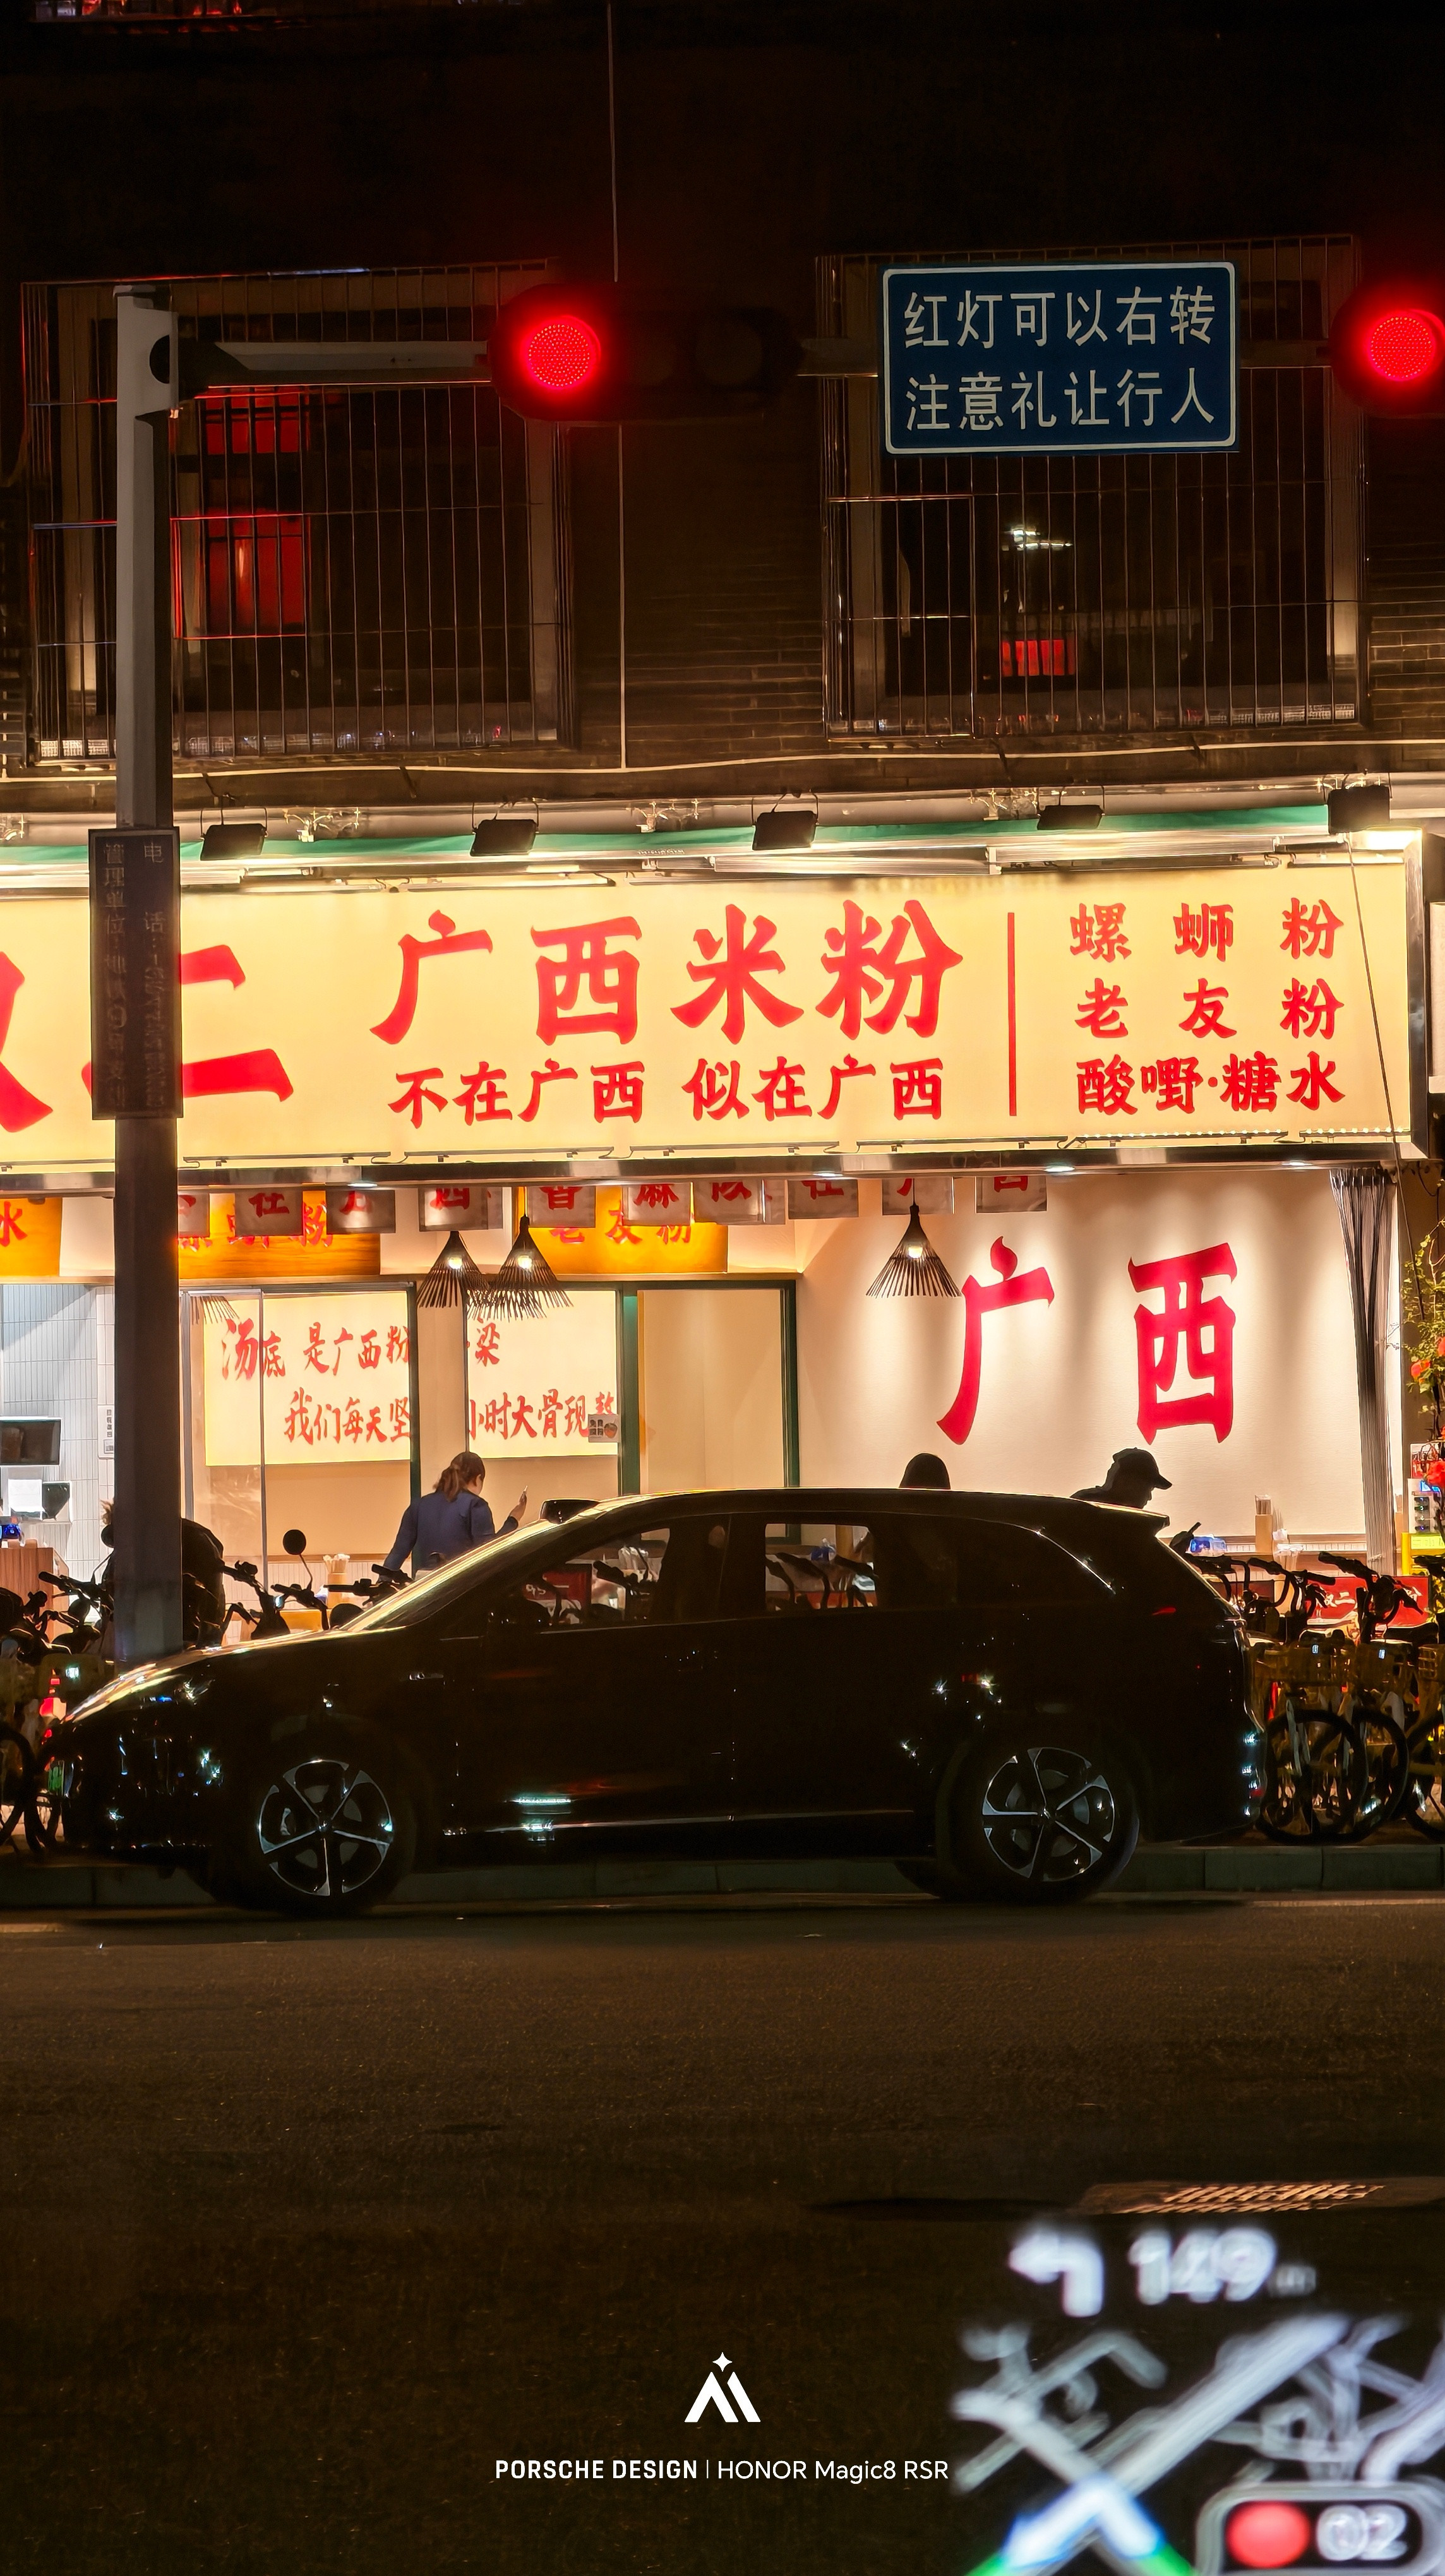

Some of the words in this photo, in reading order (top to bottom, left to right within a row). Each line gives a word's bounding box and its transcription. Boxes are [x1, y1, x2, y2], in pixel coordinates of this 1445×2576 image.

[904, 285, 1215, 349] 红灯可以右转
[906, 367, 1215, 431] 注意礼让行人
[1070, 897, 1344, 963] 螺蛳粉
[370, 900, 963, 1046] 广西米粉
[1075, 977, 1345, 1041] 老友粉
[388, 1058, 645, 1129] 不在广西
[681, 1054, 944, 1121] 似在广西
[937, 1236, 1237, 1445] 广西
